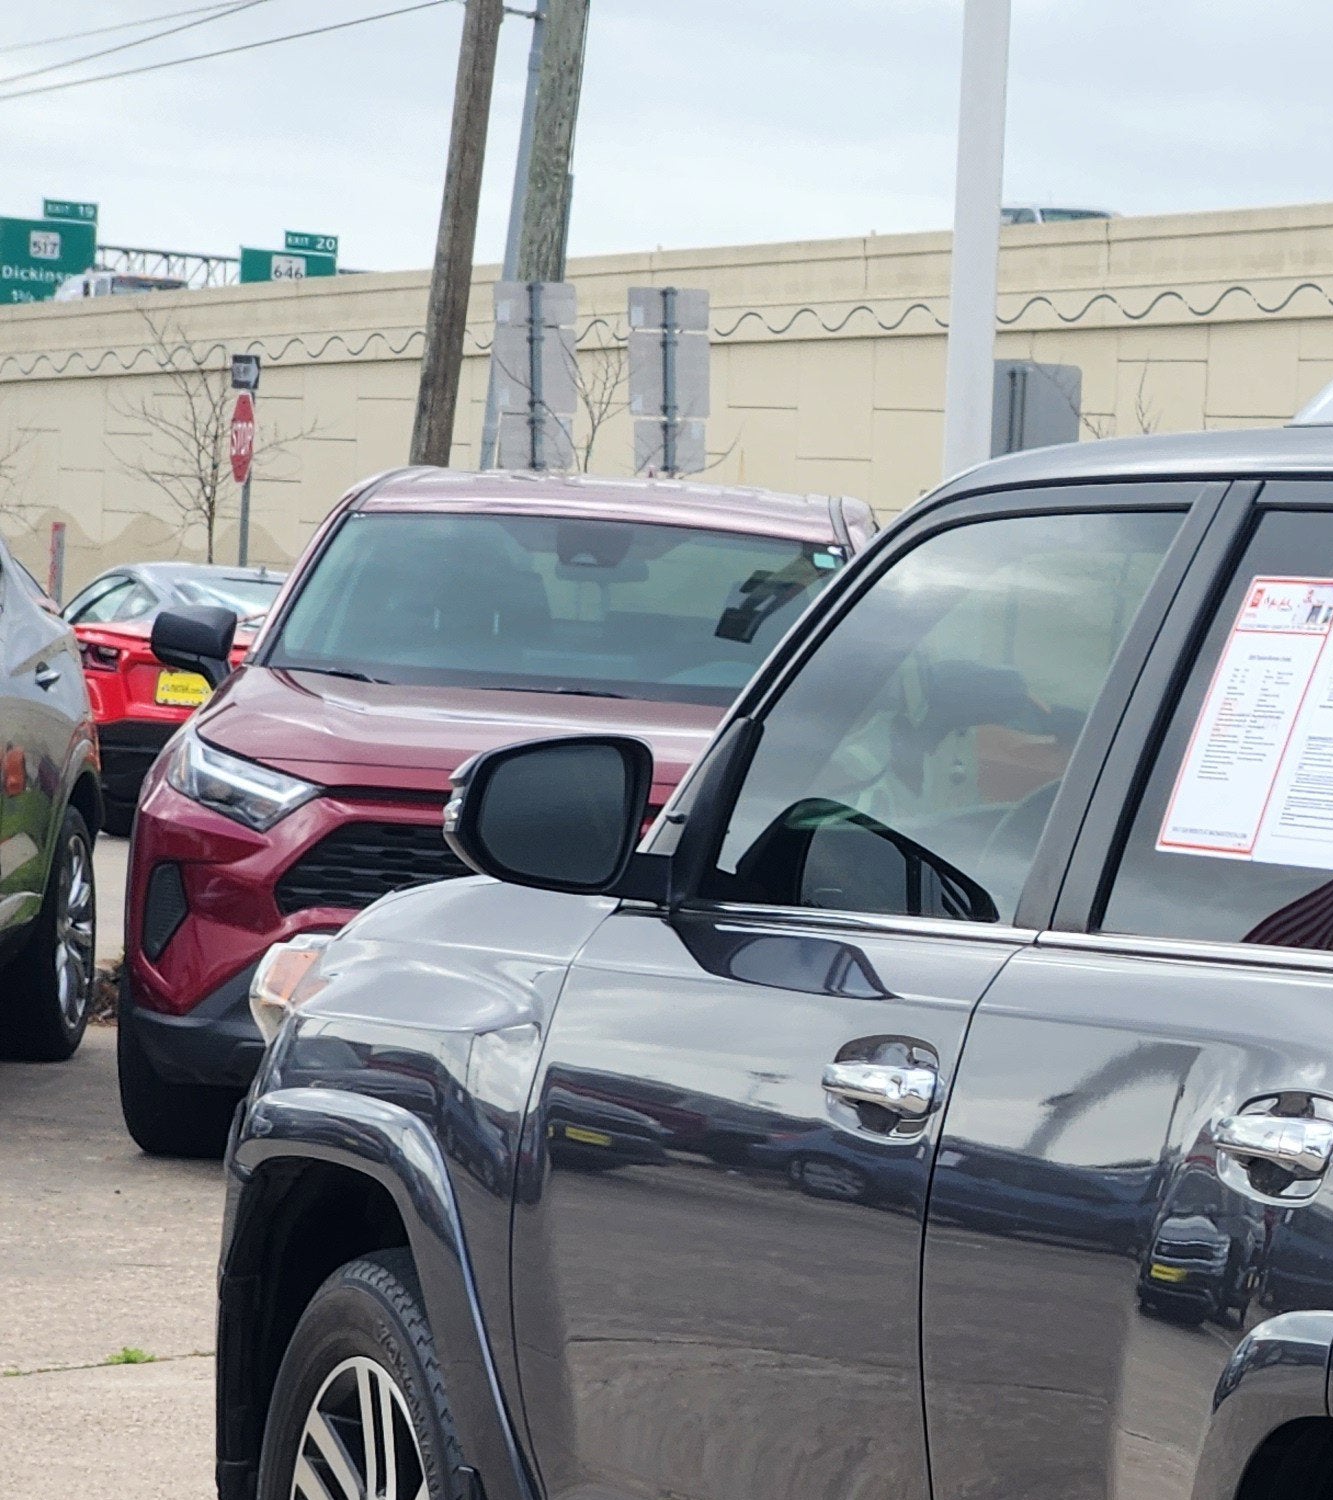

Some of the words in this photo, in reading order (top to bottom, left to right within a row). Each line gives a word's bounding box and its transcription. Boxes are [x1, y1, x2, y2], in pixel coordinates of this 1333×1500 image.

[33, 241, 58, 254] 517
[287, 235, 309, 246] EXIT
[316, 238, 335, 250] 20
[274, 264, 303, 280] 646
